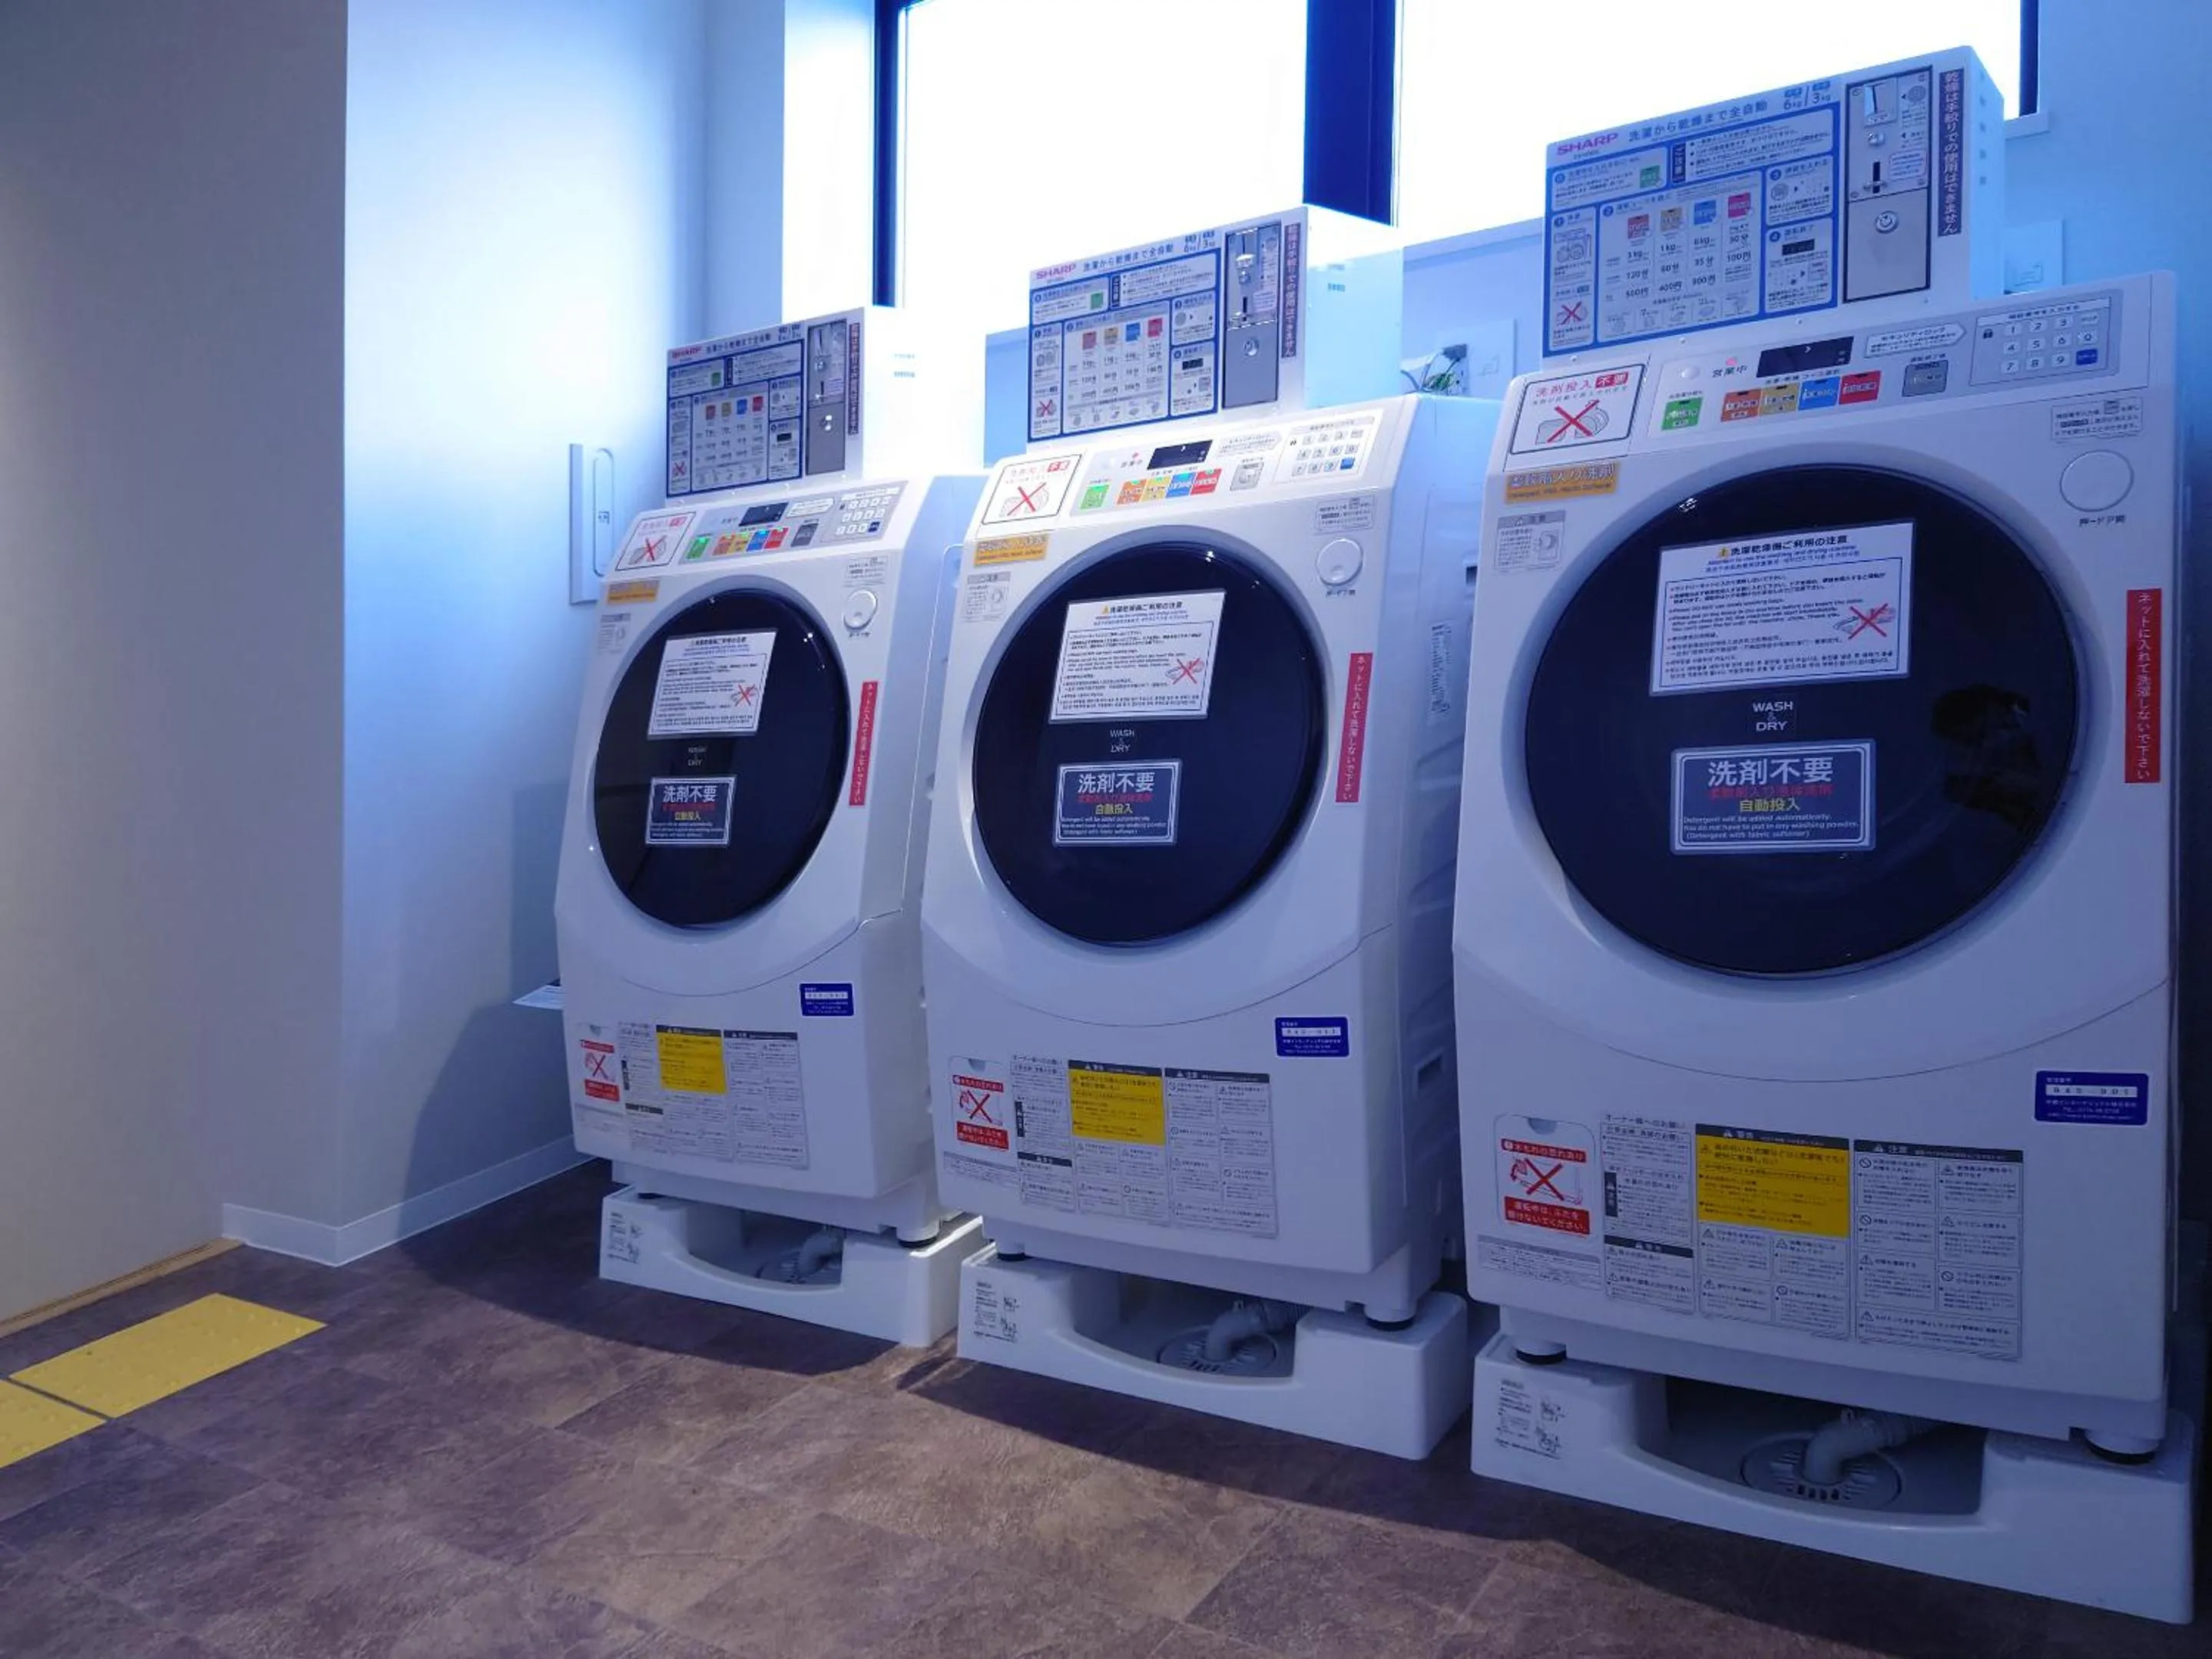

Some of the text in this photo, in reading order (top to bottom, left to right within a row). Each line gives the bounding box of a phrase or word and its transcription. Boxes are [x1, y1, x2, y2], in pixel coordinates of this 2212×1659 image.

[1628, 101, 1768, 142] 洗濯から乾燥まで全自動
[1556, 132, 1619, 156] SHARP
[1036, 263, 1076, 280] SHARP
[1711, 365, 1747, 379] 営業中
[1730, 535, 1848, 556] 洗濯乾燥機ご利用の注意
[2137, 592, 2151, 780] ネットに入れて洗濯しないで下さい
[1753, 701, 1794, 712] WASH
[1109, 729, 1135, 738] WASH
[1756, 721, 1788, 731] DRY
[1110, 743, 1131, 753] DRY
[1707, 756, 1834, 787] 洗剤不要
[1077, 771, 1155, 794] 洗剤不要
[663, 784, 719, 803] 洗剤不要
[1095, 803, 1134, 816] 自動投入
[1739, 796, 1801, 813] 自動投入
